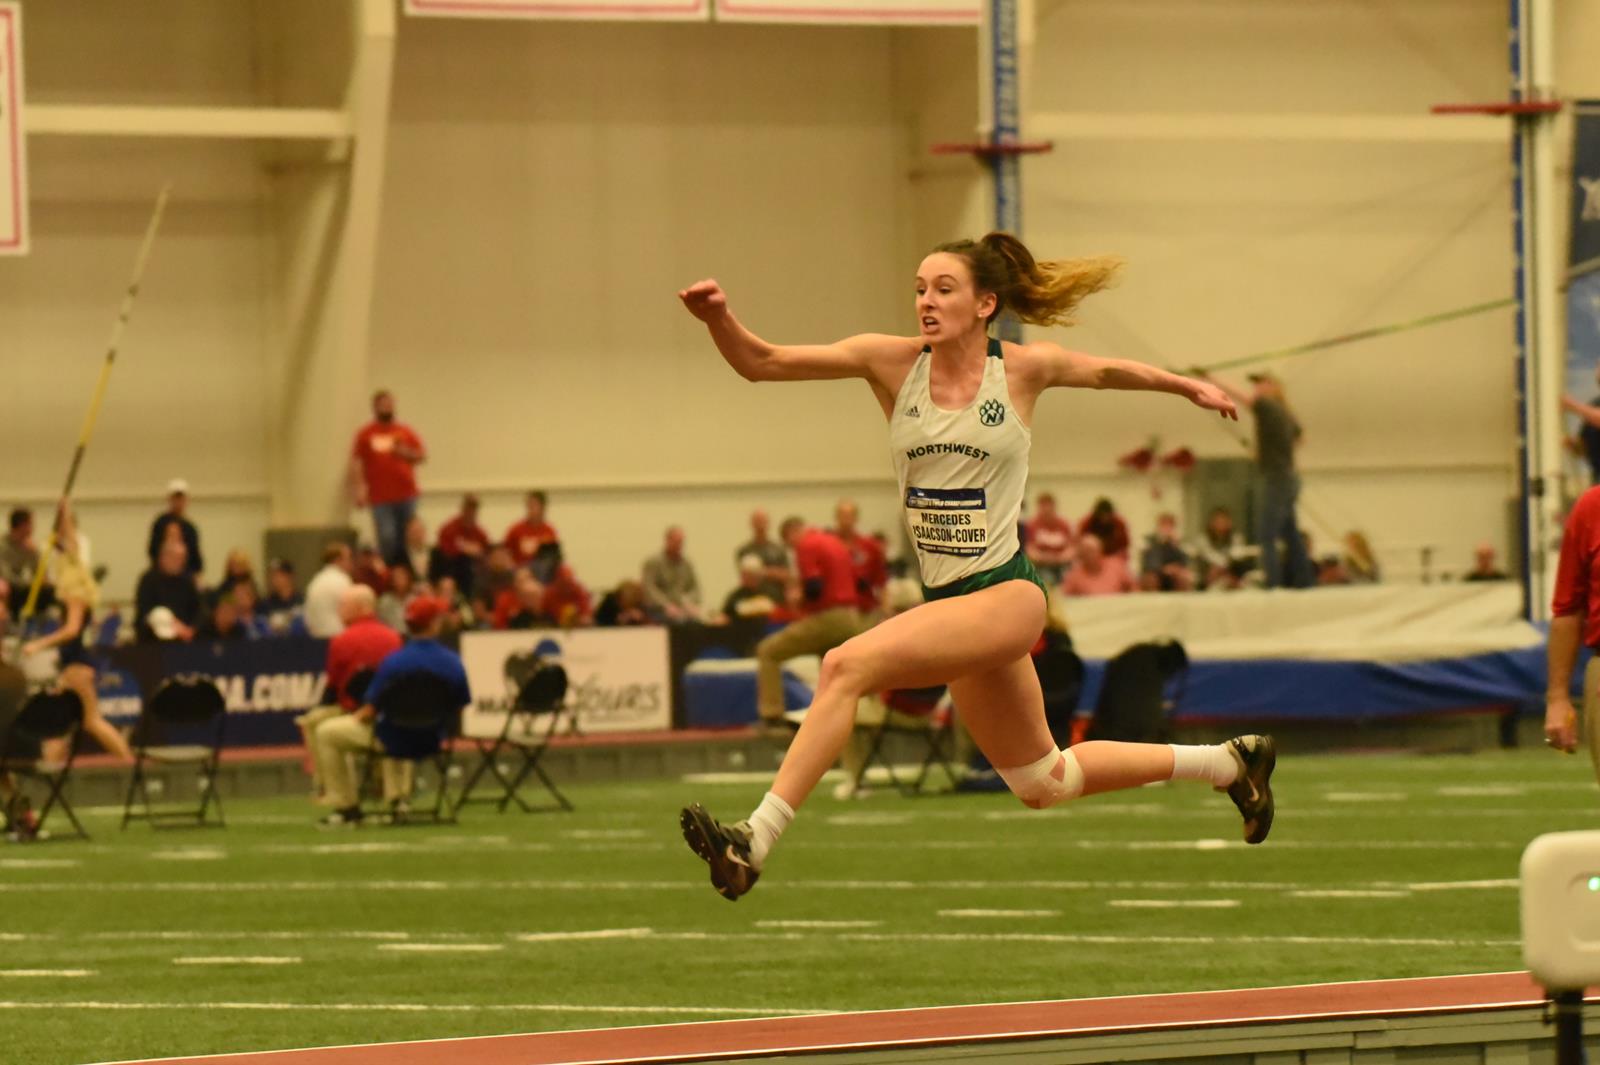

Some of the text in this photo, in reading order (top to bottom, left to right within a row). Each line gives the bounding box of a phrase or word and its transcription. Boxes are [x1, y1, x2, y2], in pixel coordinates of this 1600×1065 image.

[906, 443, 990, 462] NORTHWEST
[921, 512, 971, 526] MERCEDES
[912, 525, 986, 543] ISAACSON-COVER
